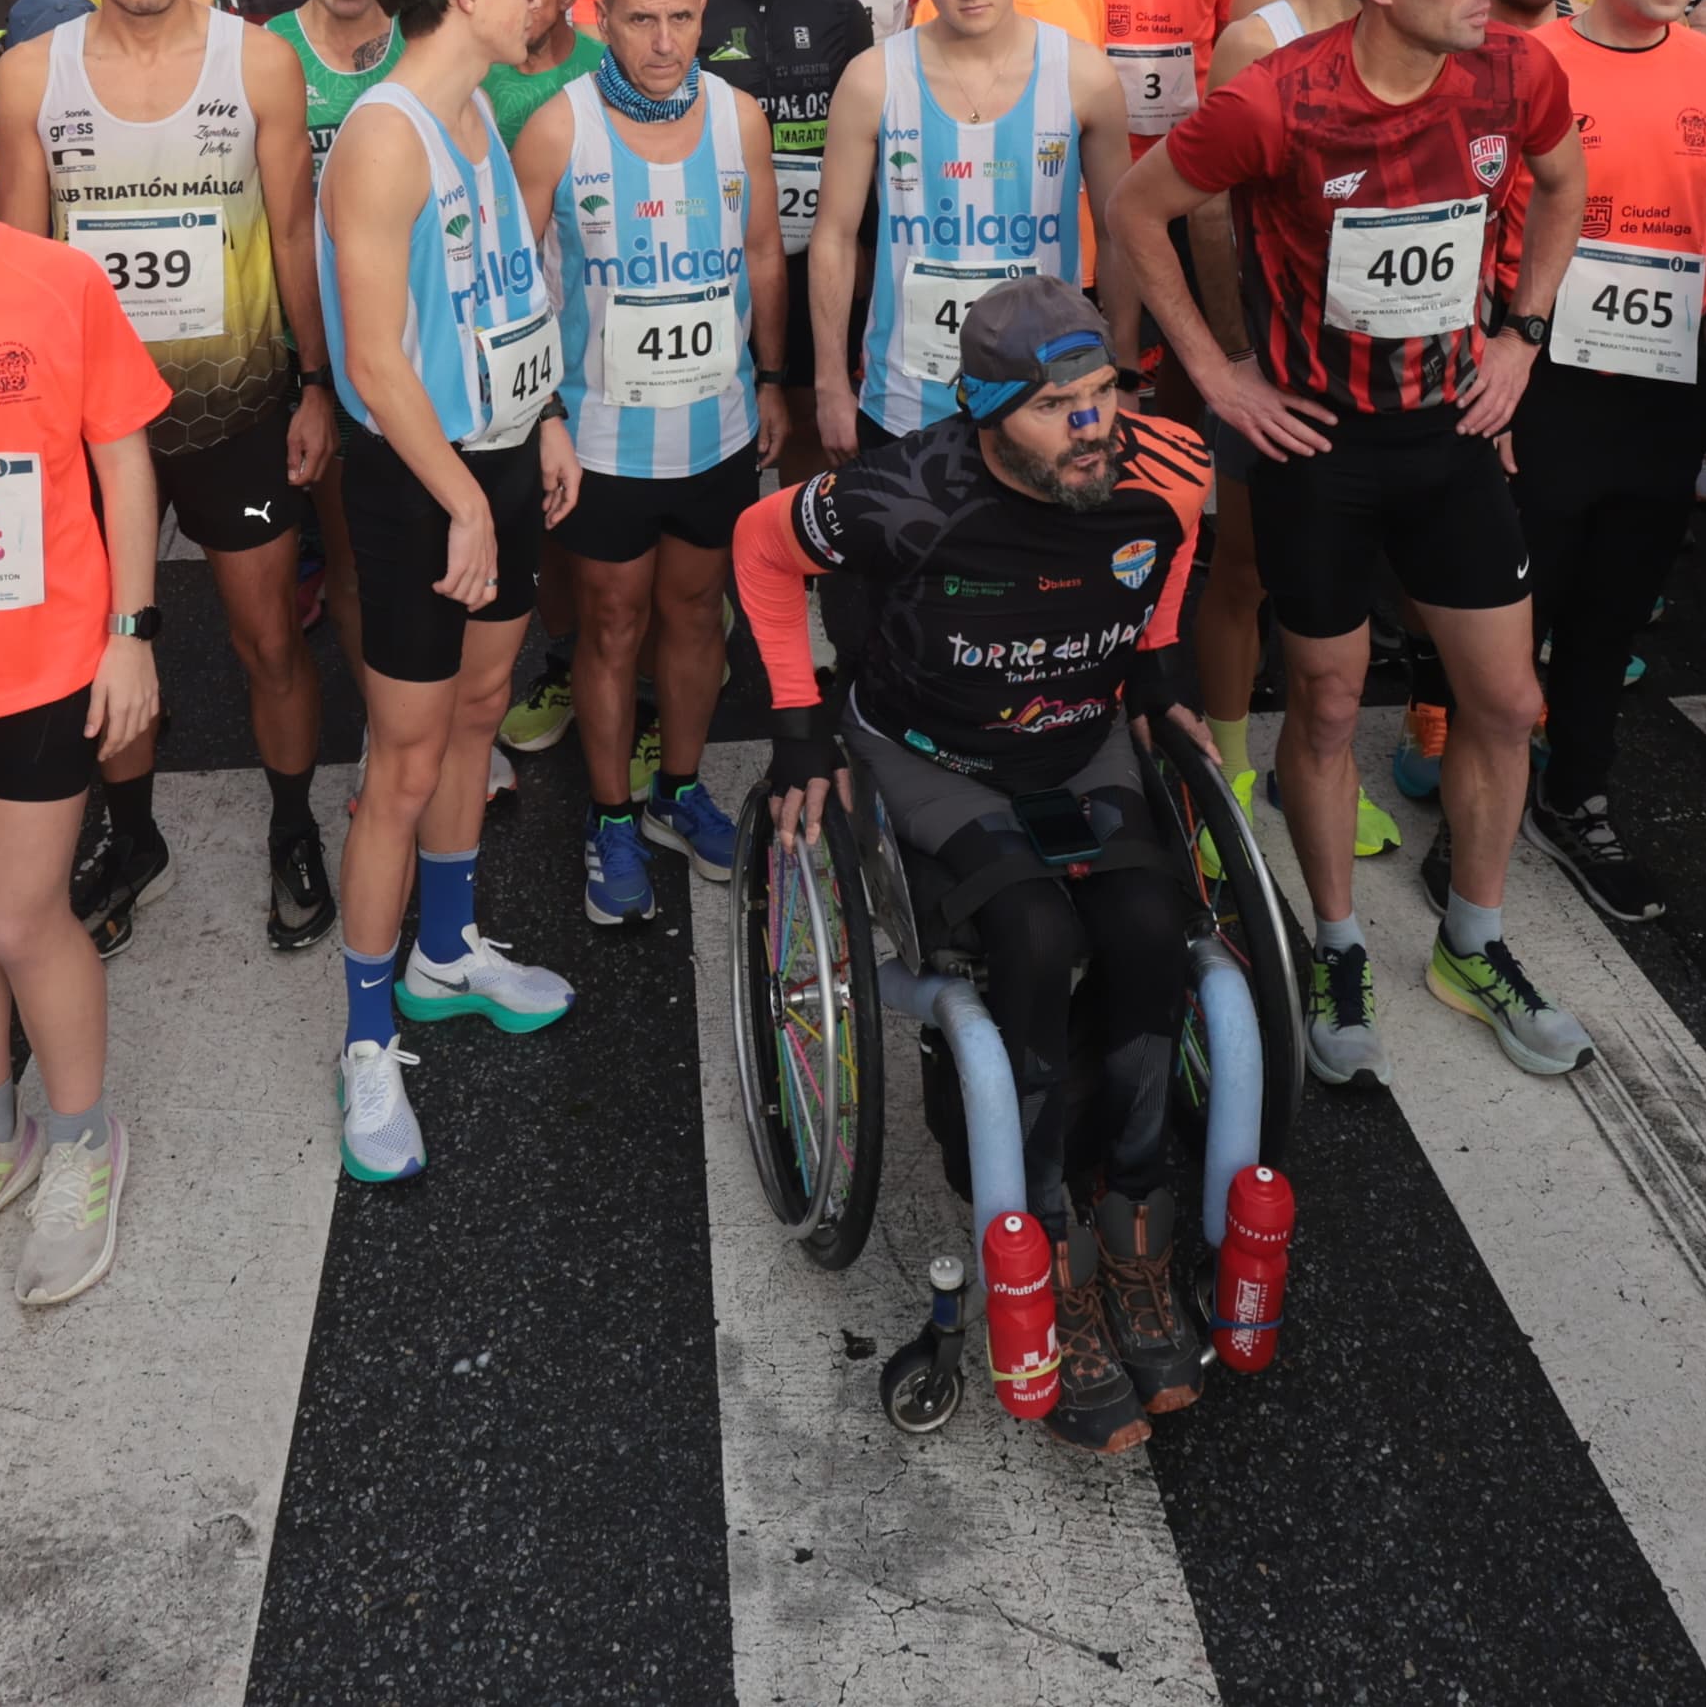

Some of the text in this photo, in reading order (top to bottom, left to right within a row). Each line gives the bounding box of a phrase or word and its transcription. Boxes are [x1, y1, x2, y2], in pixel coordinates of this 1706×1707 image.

[1136, 12, 1171, 23] Ciudad
[1152, 25, 1184, 35] Málaga
[1144, 73, 1162, 100] 3
[885, 128, 919, 140] vive
[84, 177, 177, 201] TRIATLÓN
[574, 172, 611, 186] vive
[438, 184, 466, 209] vive
[1621, 205, 1671, 219] Ciudad
[1620, 221, 1692, 236] de Málaga
[104, 250, 191, 289] 339
[1367, 242, 1454, 287] 406
[1592, 284, 1673, 328] 465
[637, 321, 713, 361] 410
[512, 345, 552, 402] 414
[1053, 633, 1090, 660] del
